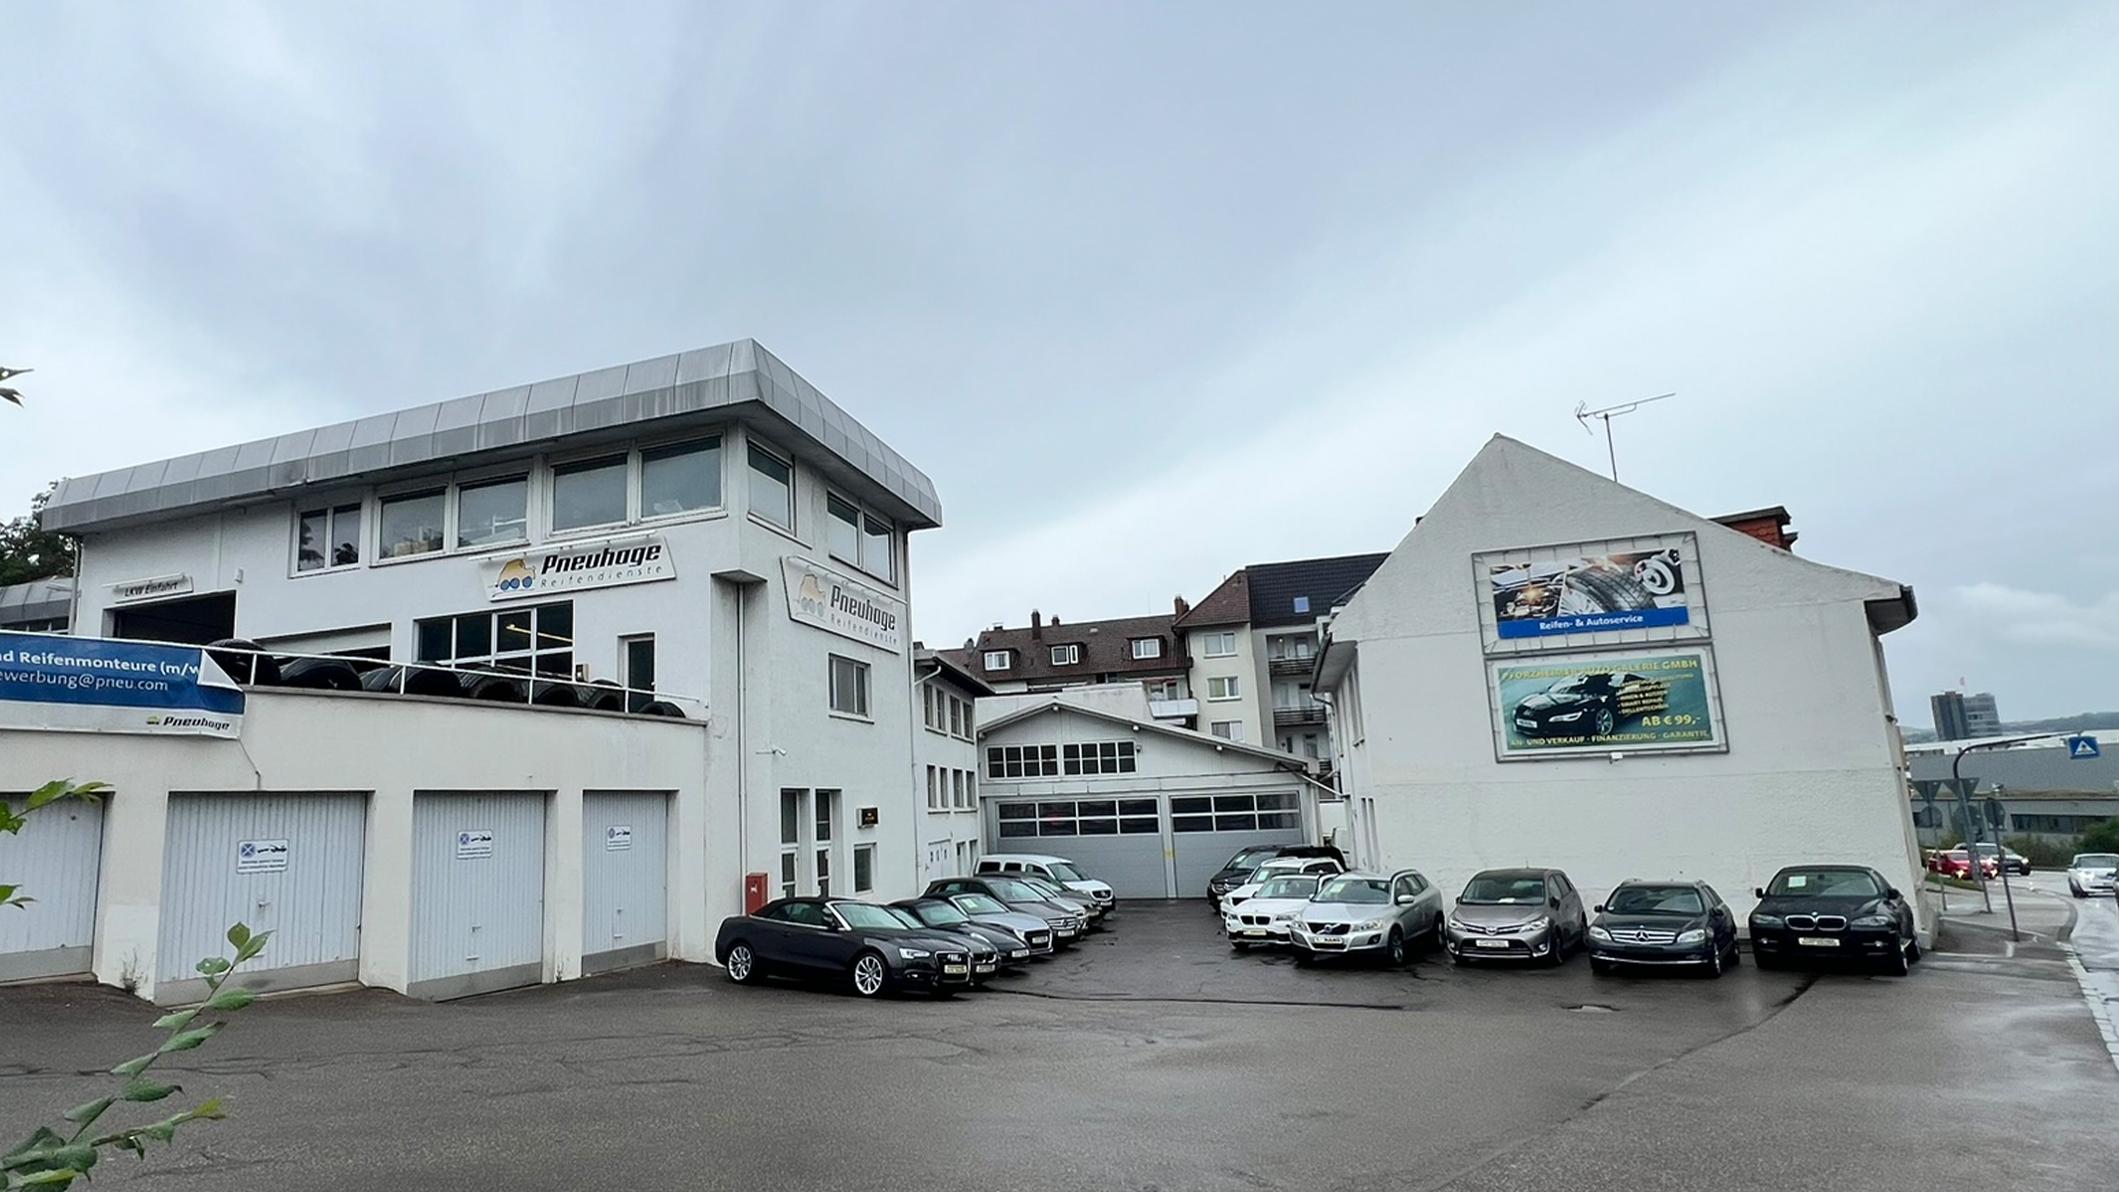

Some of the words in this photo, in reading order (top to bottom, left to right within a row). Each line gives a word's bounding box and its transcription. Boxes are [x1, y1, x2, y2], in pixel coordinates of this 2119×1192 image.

[541, 545, 662, 575] Pneuhage
[541, 565, 663, 588] Reifendienste
[830, 585, 896, 632] Pneuhage
[1539, 620, 1573, 630] Reifen-
[1586, 615, 1644, 627] Autoservice
[20, 651, 156, 672] Reifenmonteure
[1662, 660, 1698, 669] GMBH
[0, 670, 168, 691] werbung@pneu.com
[163, 716, 230, 731] Pneuhage
[1641, 716, 1661, 727] AB
[1663, 715, 1673, 726] €
